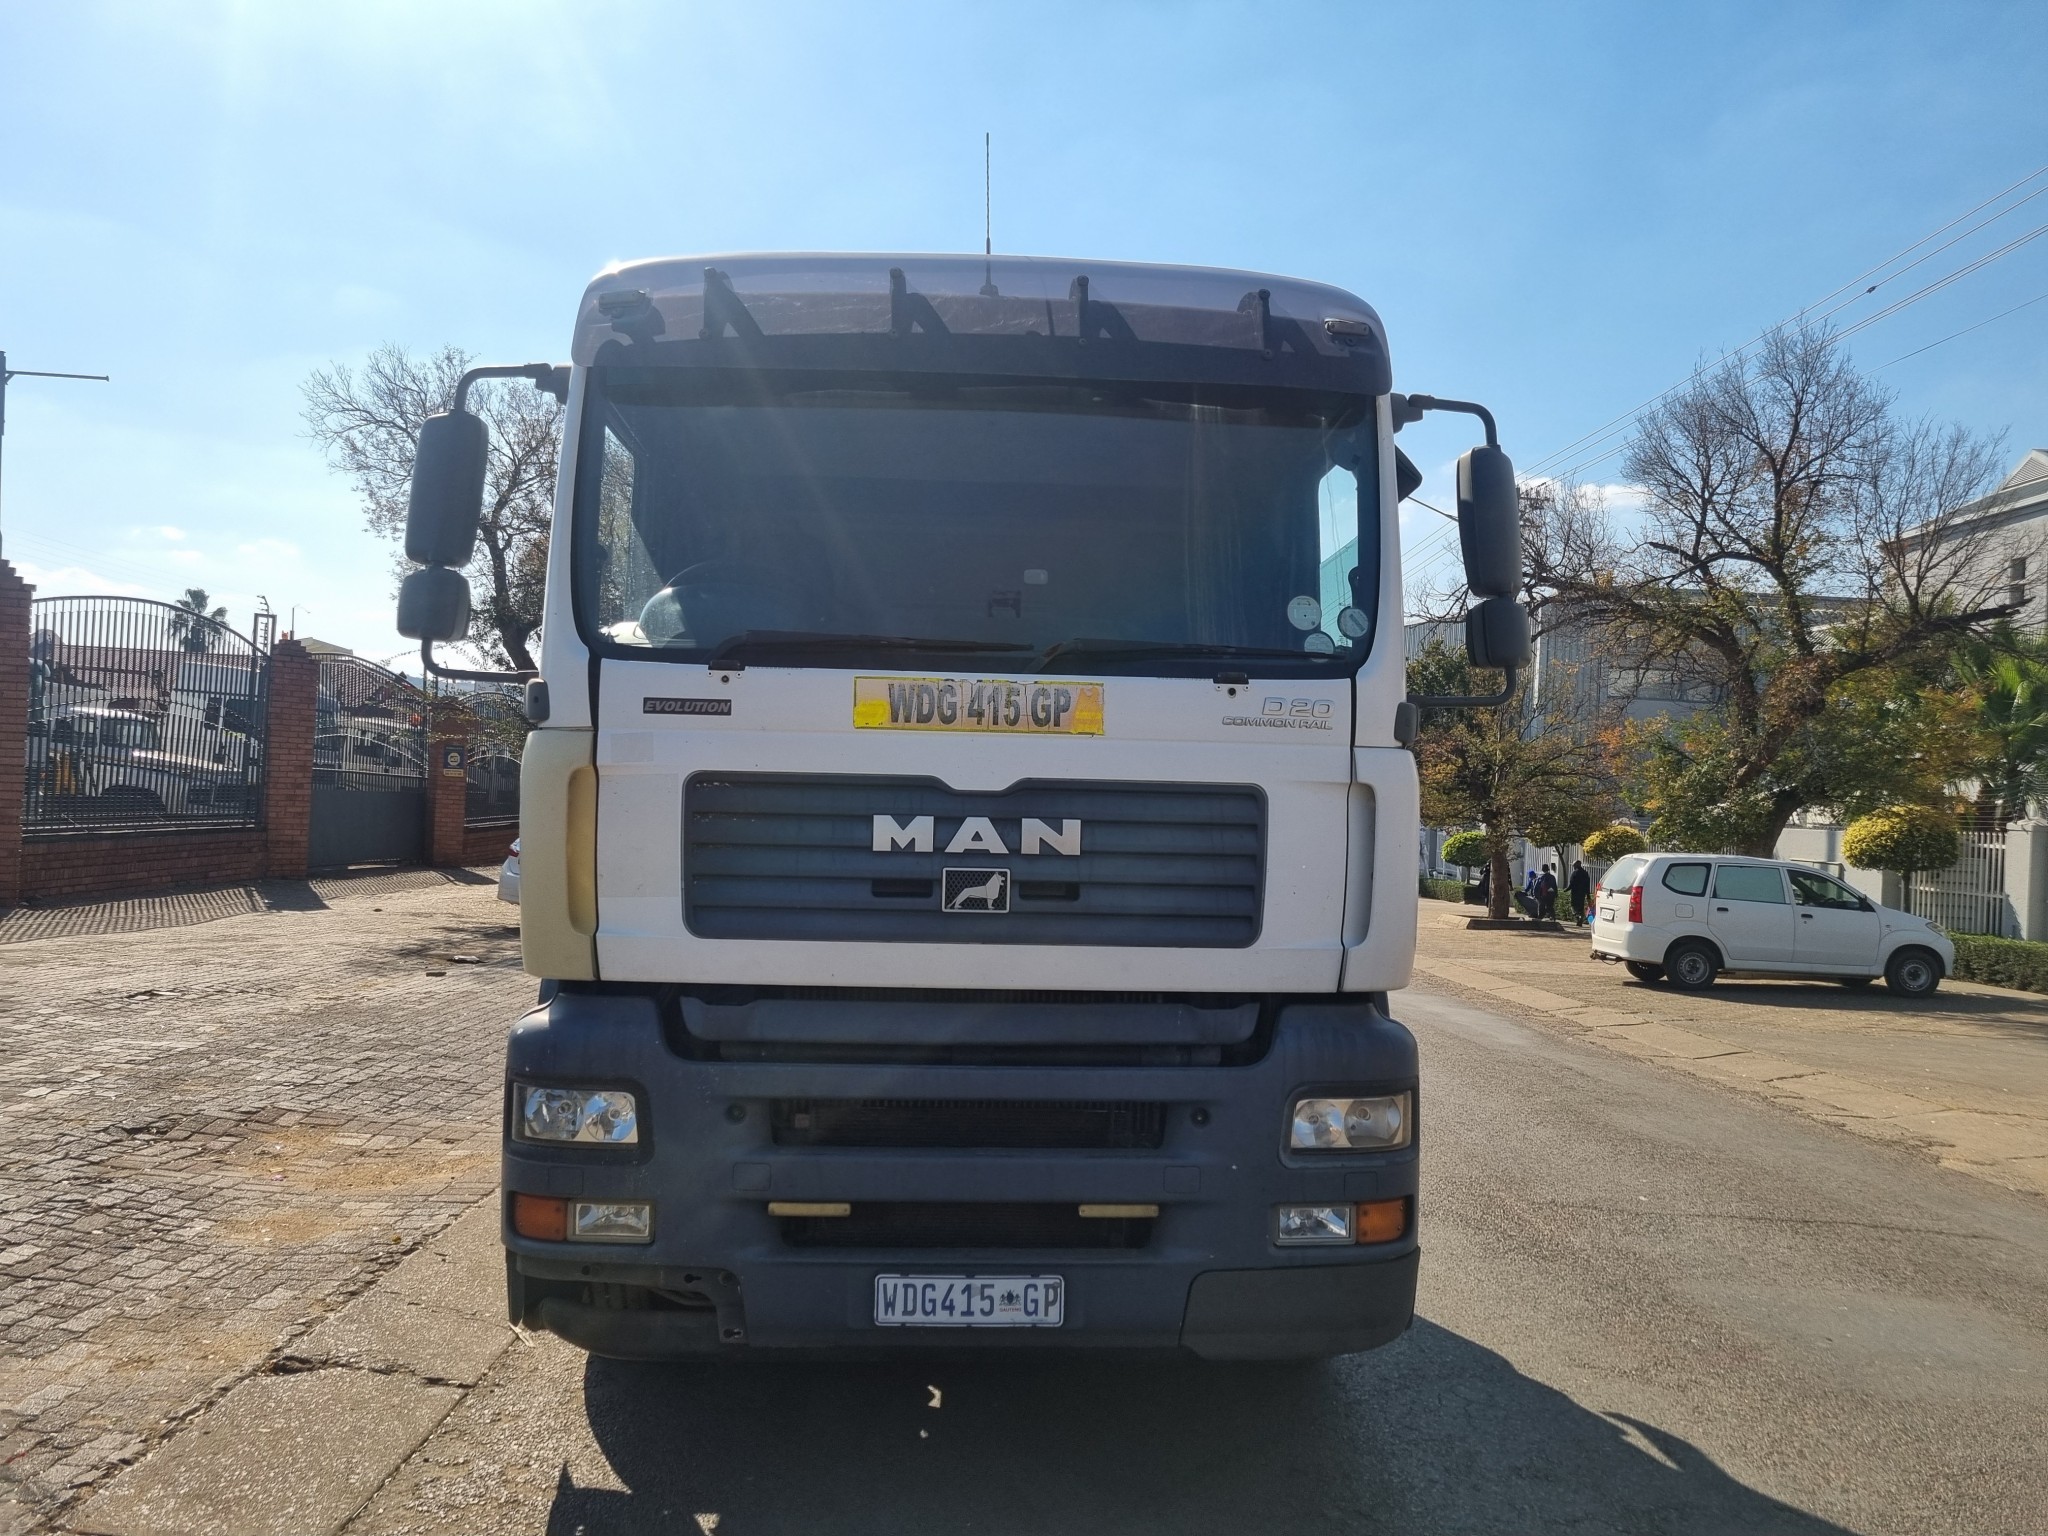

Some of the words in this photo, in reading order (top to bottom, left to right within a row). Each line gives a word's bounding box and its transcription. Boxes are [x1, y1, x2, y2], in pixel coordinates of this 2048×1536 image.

[644, 700, 731, 713] EVOLUTION
[888, 683, 957, 725] WDG
[967, 685, 1021, 727] 415
[1031, 687, 1072, 728] GP
[1222, 716, 1296, 729] COMMON
[1299, 719, 1333, 730] RAIL
[872, 814, 1081, 856] MAN
[1023, 1283, 1060, 1317] GP
